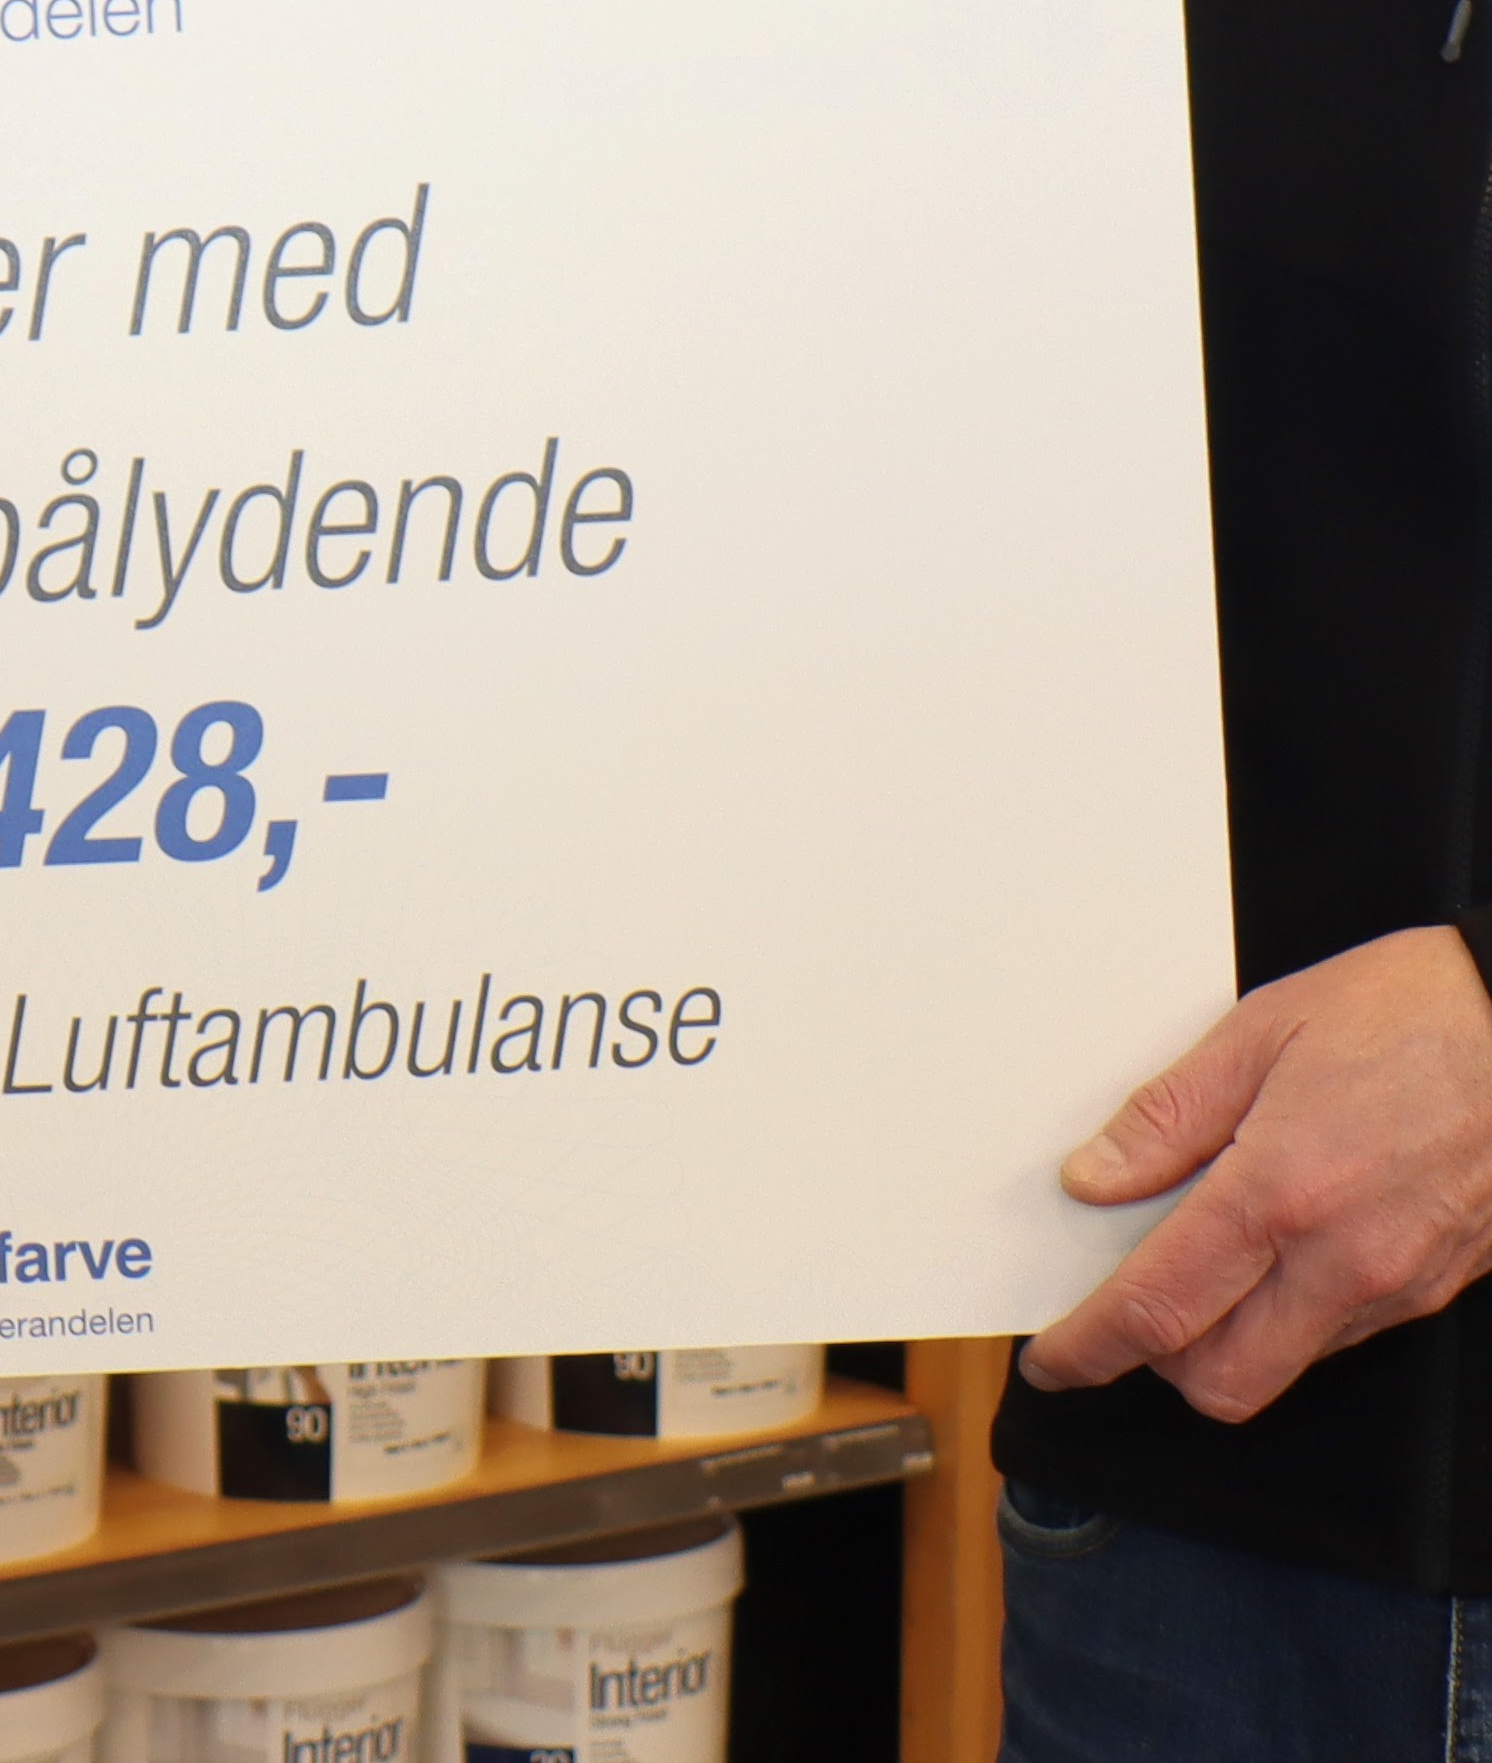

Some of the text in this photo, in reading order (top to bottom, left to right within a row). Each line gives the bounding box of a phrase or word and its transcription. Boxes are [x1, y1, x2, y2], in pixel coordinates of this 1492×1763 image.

[126, 181, 431, 338] med
[1, 973, 725, 1098] Luftambulanse
[286, 1406, 327, 1442] 90
[588, 1649, 714, 1714] Interior
